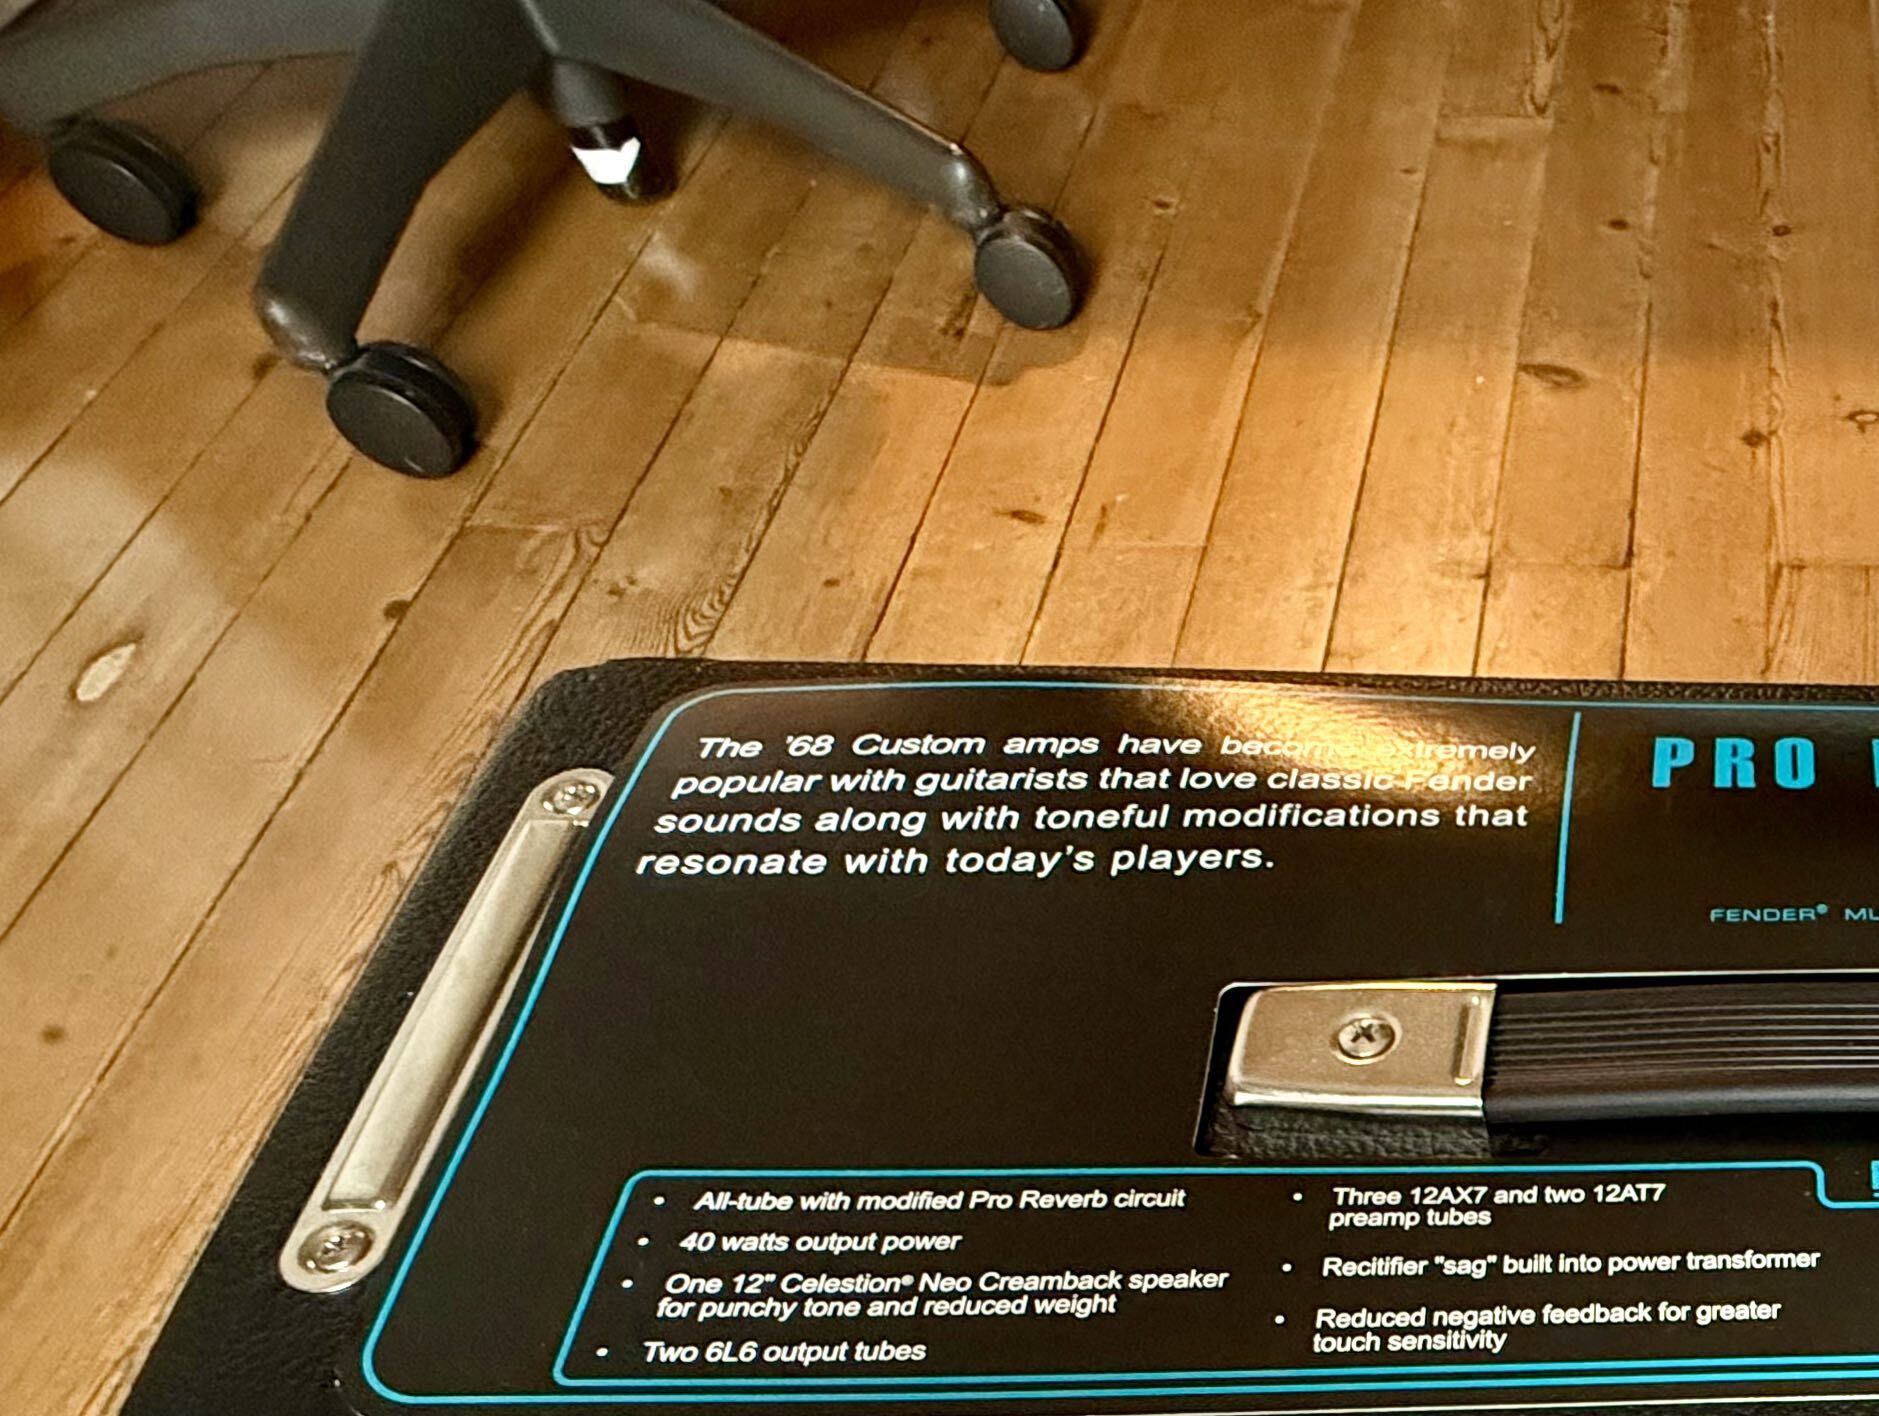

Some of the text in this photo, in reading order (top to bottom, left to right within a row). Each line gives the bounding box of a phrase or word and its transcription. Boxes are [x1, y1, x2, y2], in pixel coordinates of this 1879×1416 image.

[700, 737, 763, 758] The
[852, 734, 986, 755] Custom
[1003, 737, 1099, 758] amps
[1118, 734, 1202, 754] have
[1652, 737, 1816, 788] PRO
[671, 770, 823, 800] popular
[831, 768, 906, 792] with
[914, 767, 1088, 796] guitarists
[1100, 767, 1171, 789] that
[1180, 768, 1257, 789] love
[1267, 768, 1396, 790] classic
[654, 803, 1527, 837] sounds along with toneful modifications that
[636, 845, 1273, 878] resonate with today's players.
[693, 1189, 1186, 1211] All-tube with modified Pro Reverb circuit
[1333, 1183, 1666, 1205] Three 12AX7 and two 12AT7
[1329, 1207, 1492, 1231] preamp tubes
[679, 1232, 963, 1255] 40 watts output power
[1503, 1254, 1553, 1274] built
[1558, 1253, 1602, 1272] into
[1608, 1255, 1681, 1276] power
[1686, 1249, 1821, 1270] transformer
[665, 1273, 723, 1294] One
[918, 1273, 972, 1292] Neo
[979, 1270, 1123, 1291] Creamback
[1128, 1269, 1229, 1293] speaker
[657, 1293, 1117, 1322] for punchy tone and reduced weight
[1316, 1301, 1782, 1331] Reduced negative feedback for greater
[644, 1340, 926, 1367] Two 6L6 output tubes
[1313, 1329, 1508, 1353] touch sensitivity
